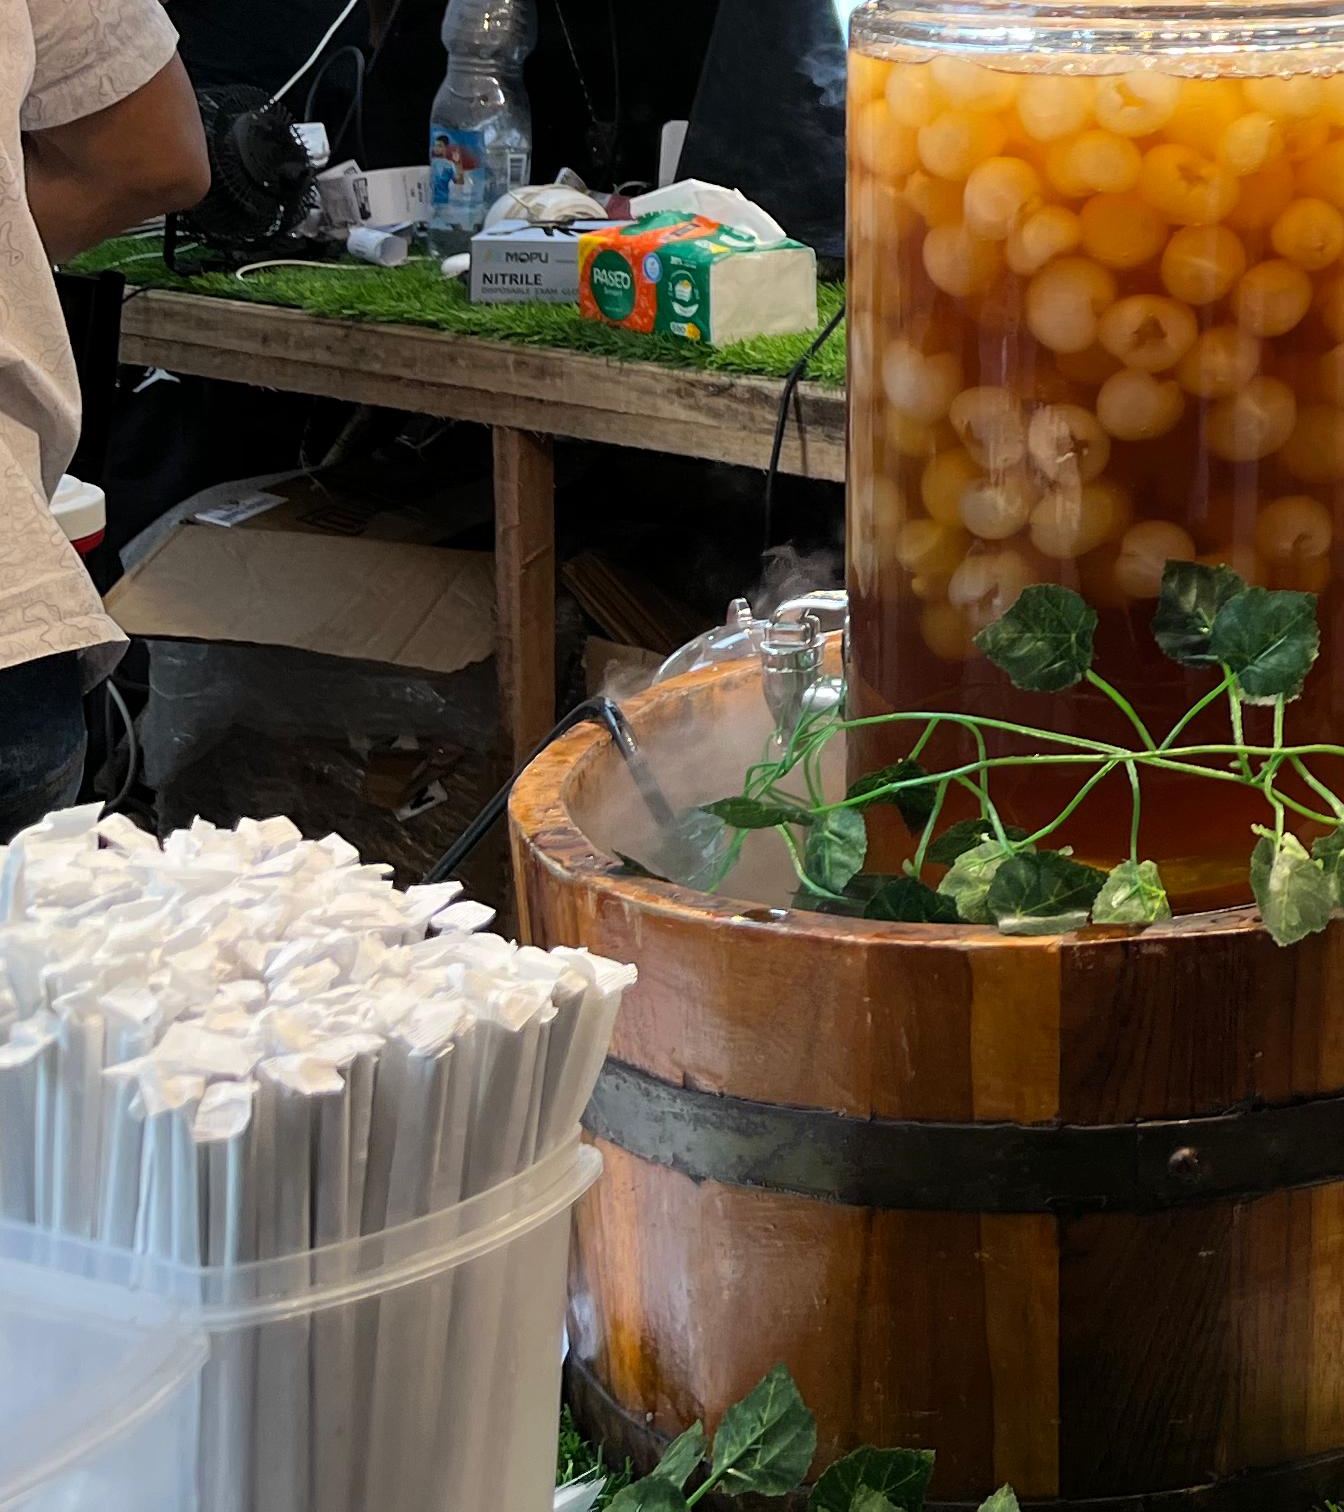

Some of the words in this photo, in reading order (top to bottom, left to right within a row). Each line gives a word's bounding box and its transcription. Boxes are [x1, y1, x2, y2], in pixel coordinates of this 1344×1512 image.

[505, 251, 549, 263] MOPU
[482, 272, 543, 286] NITRILE
[592, 267, 631, 289] PASEO
